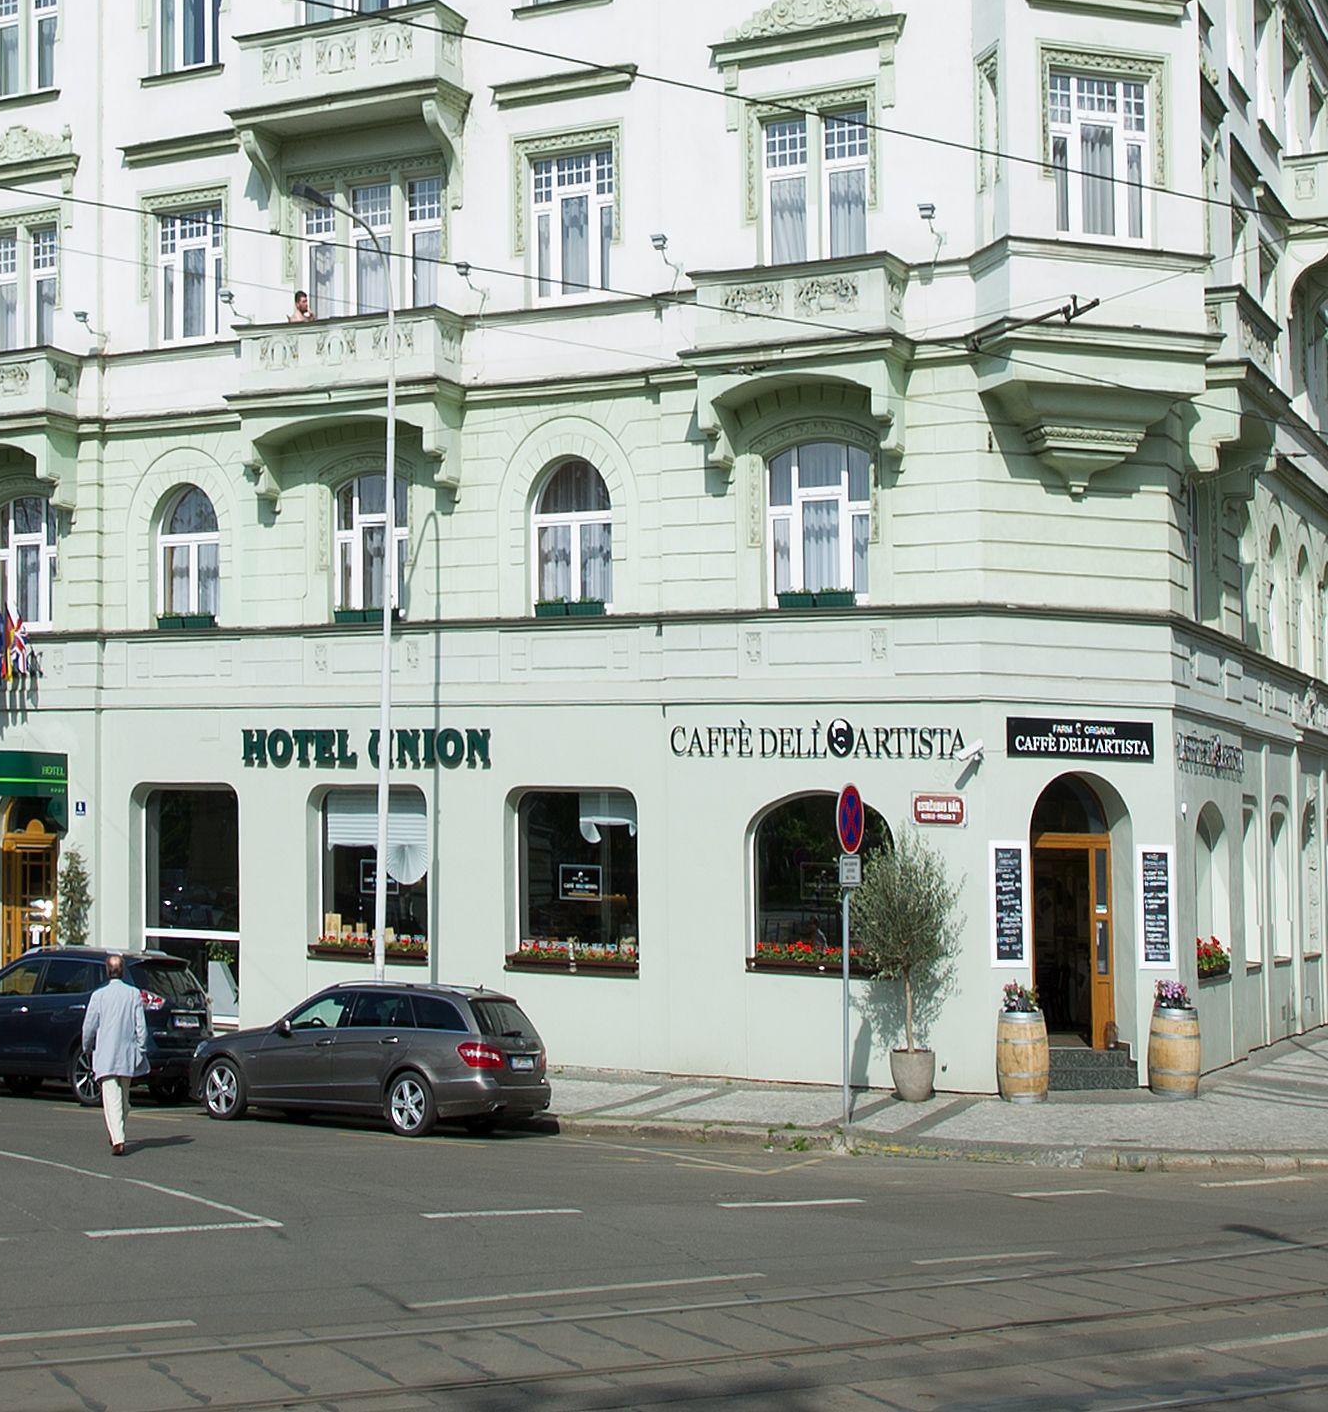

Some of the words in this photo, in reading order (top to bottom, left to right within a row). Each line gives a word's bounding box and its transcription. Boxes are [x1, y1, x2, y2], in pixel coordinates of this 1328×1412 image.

[241, 728, 359, 769] HOTEL
[367, 728, 492, 769] UNION
[670, 719, 754, 757] CAFFÈ
[1015, 733, 1057, 752] CAFFÈ
[1059, 736, 1150, 756] DELL'ARTISTA
[41, 765, 65, 777] HOTEL
